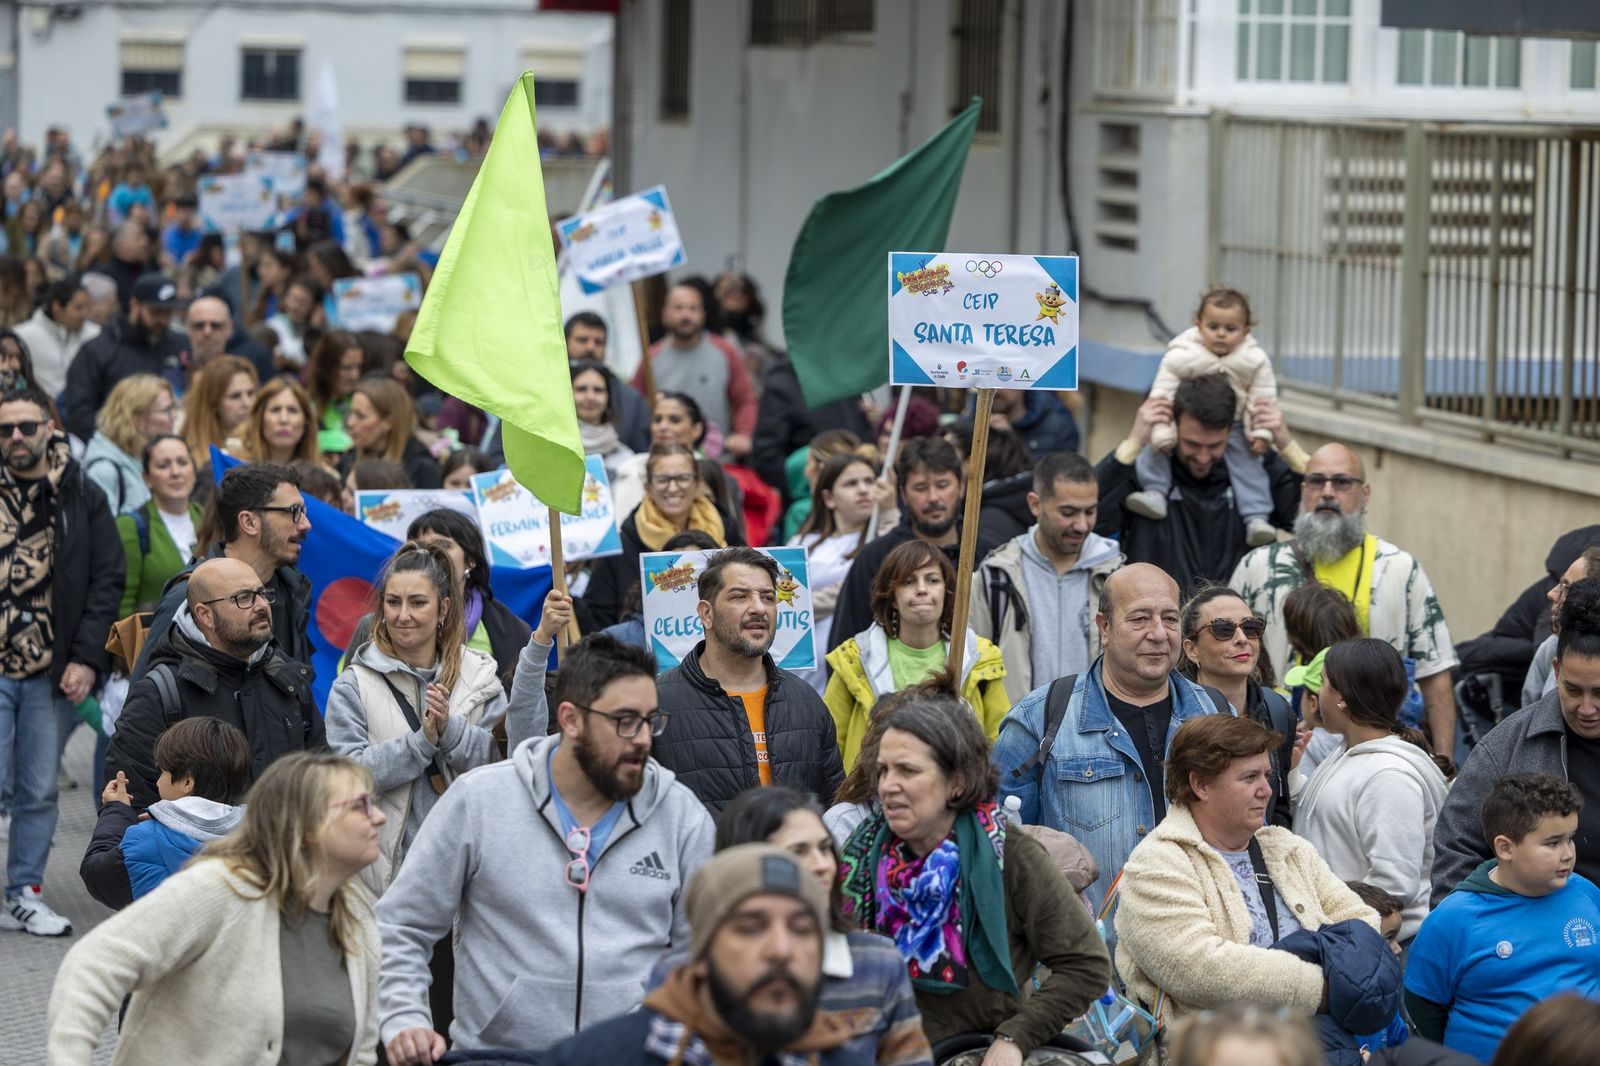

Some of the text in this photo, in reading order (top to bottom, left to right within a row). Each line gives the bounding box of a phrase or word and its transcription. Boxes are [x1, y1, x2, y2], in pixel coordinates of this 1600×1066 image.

[963, 292, 999, 310] CEIP
[913, 321, 1056, 347] SANTA TERESA
[654, 615, 704, 637] CELES
[629, 866, 671, 880] adidas
